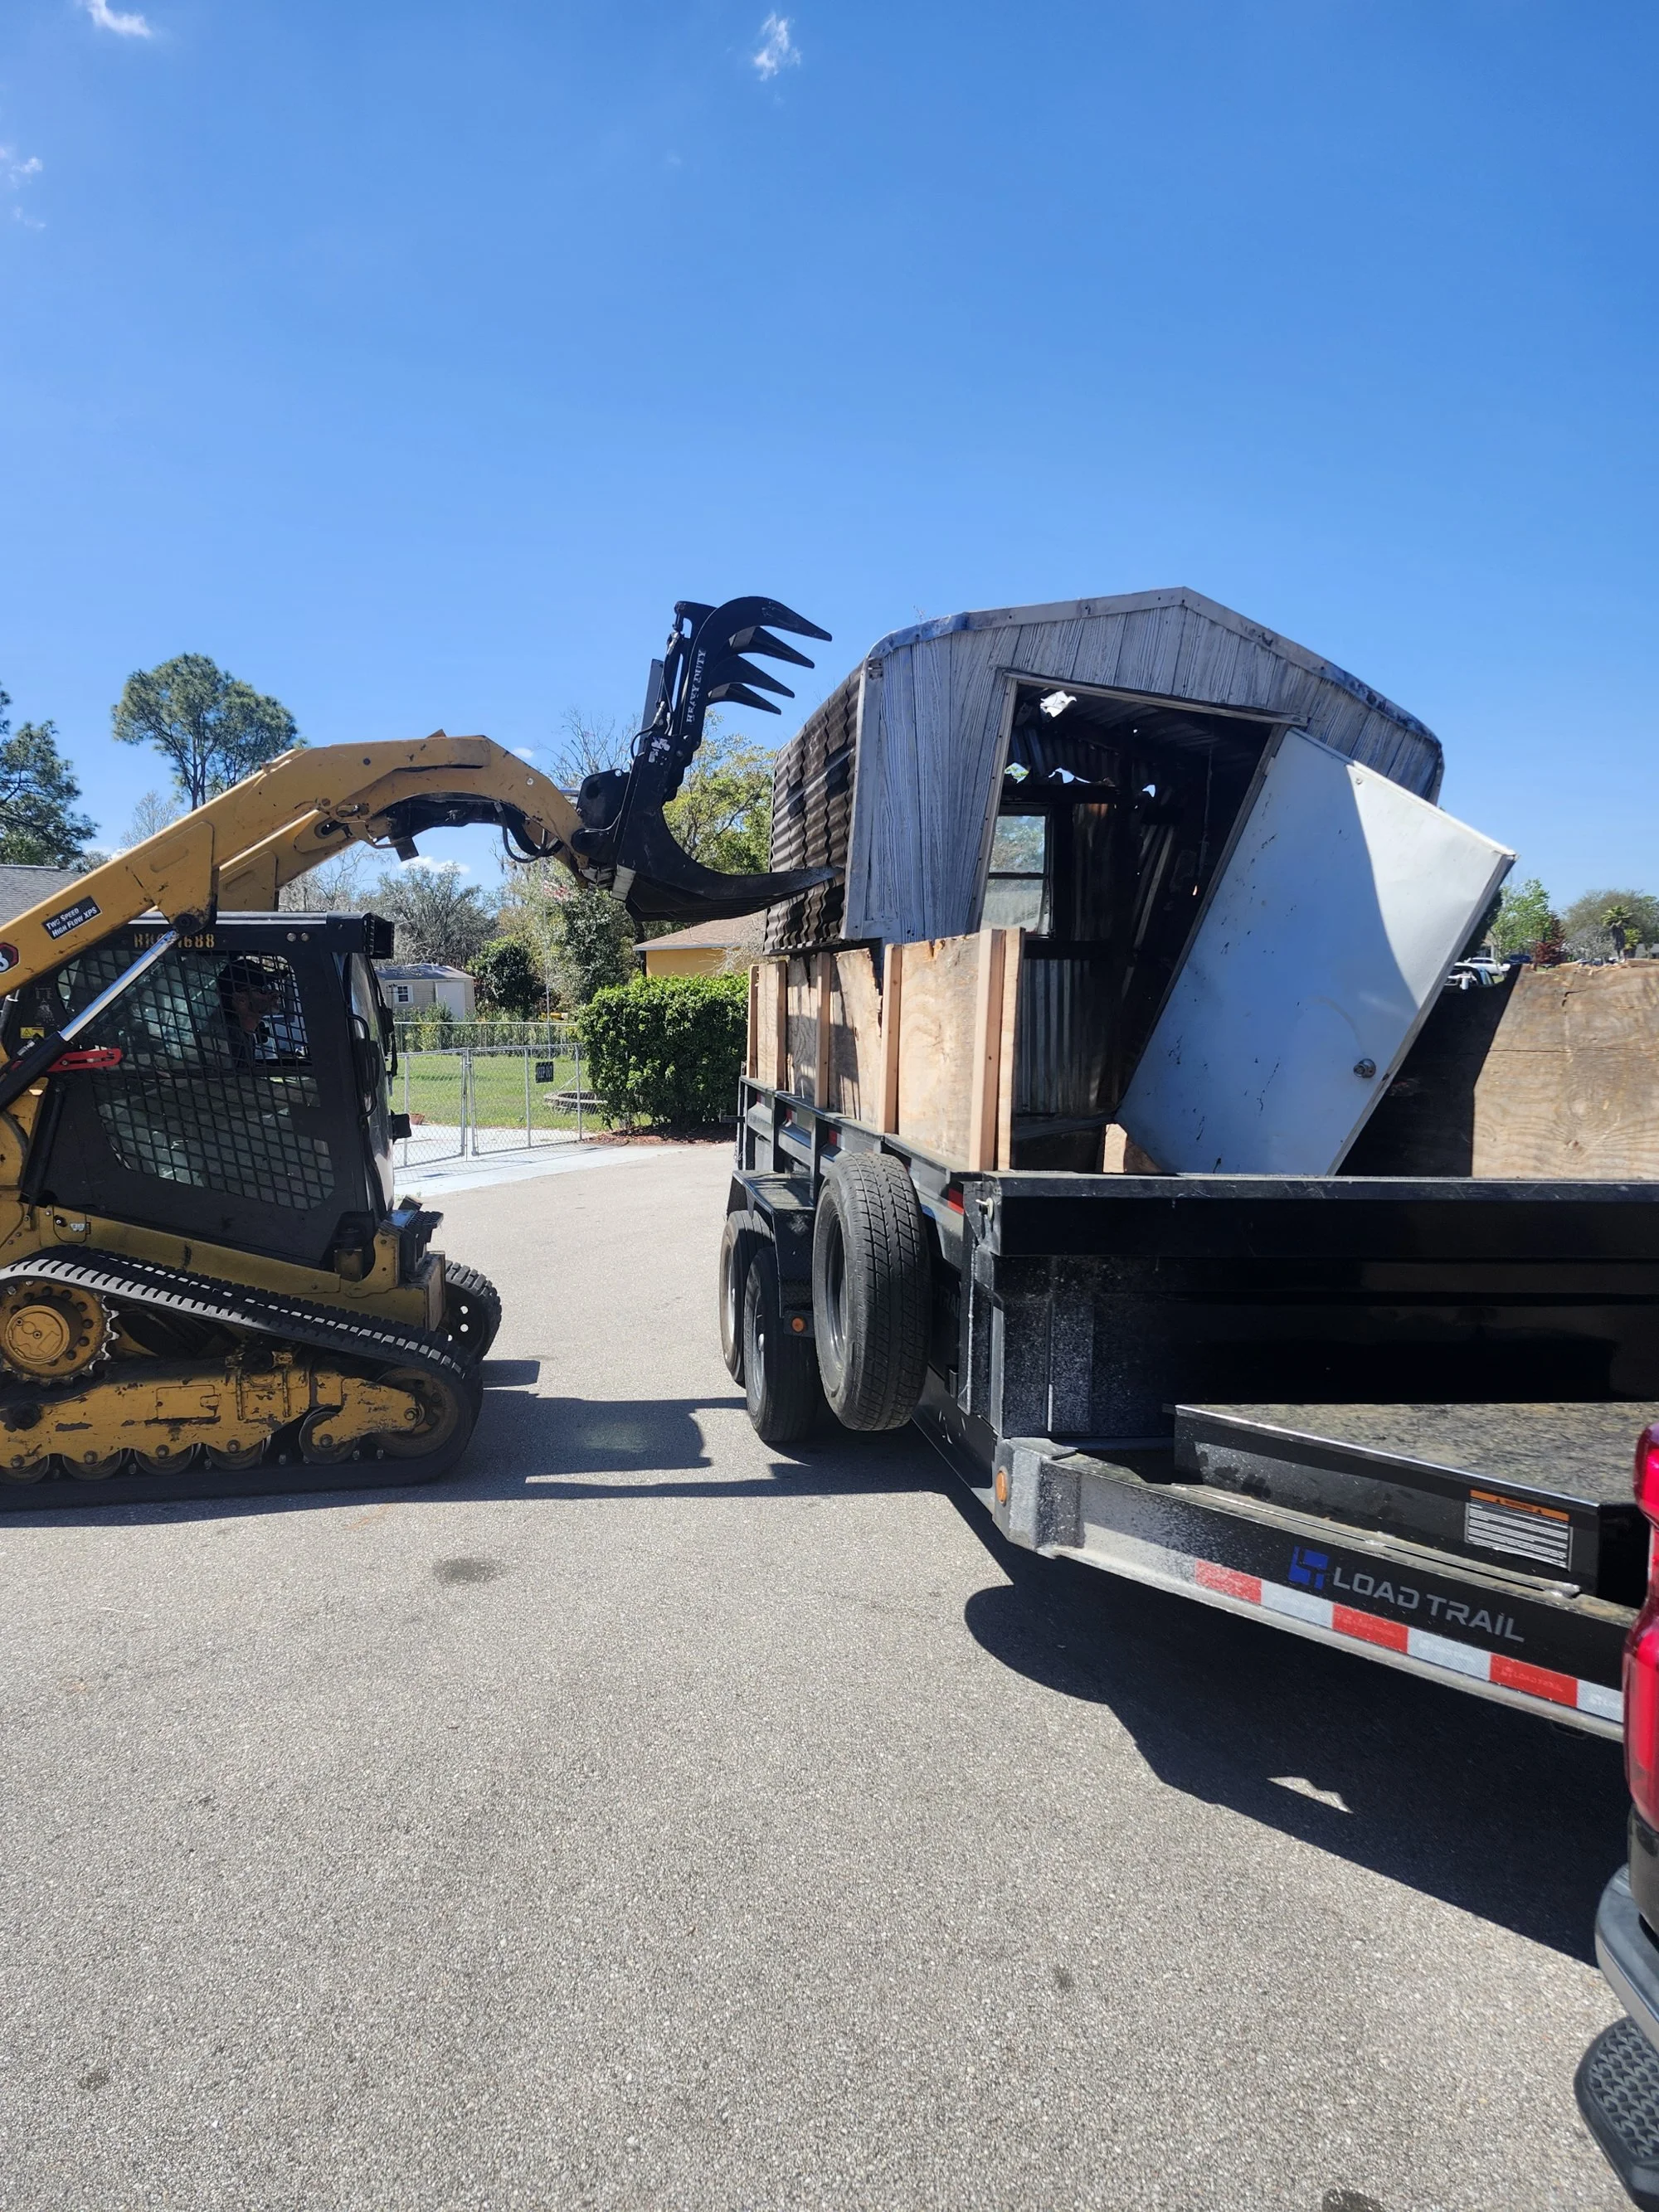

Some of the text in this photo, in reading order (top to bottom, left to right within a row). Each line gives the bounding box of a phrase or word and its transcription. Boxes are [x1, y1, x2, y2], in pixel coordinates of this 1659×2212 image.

[686, 649, 706, 723] HEAVY DUTY
[46, 907, 80, 930] TWO SPEED
[51, 907, 98, 937] HIGH FLOW XPS
[1333, 1566, 1420, 1610] LOAD
[1426, 1593, 1525, 1643] TRAIL
